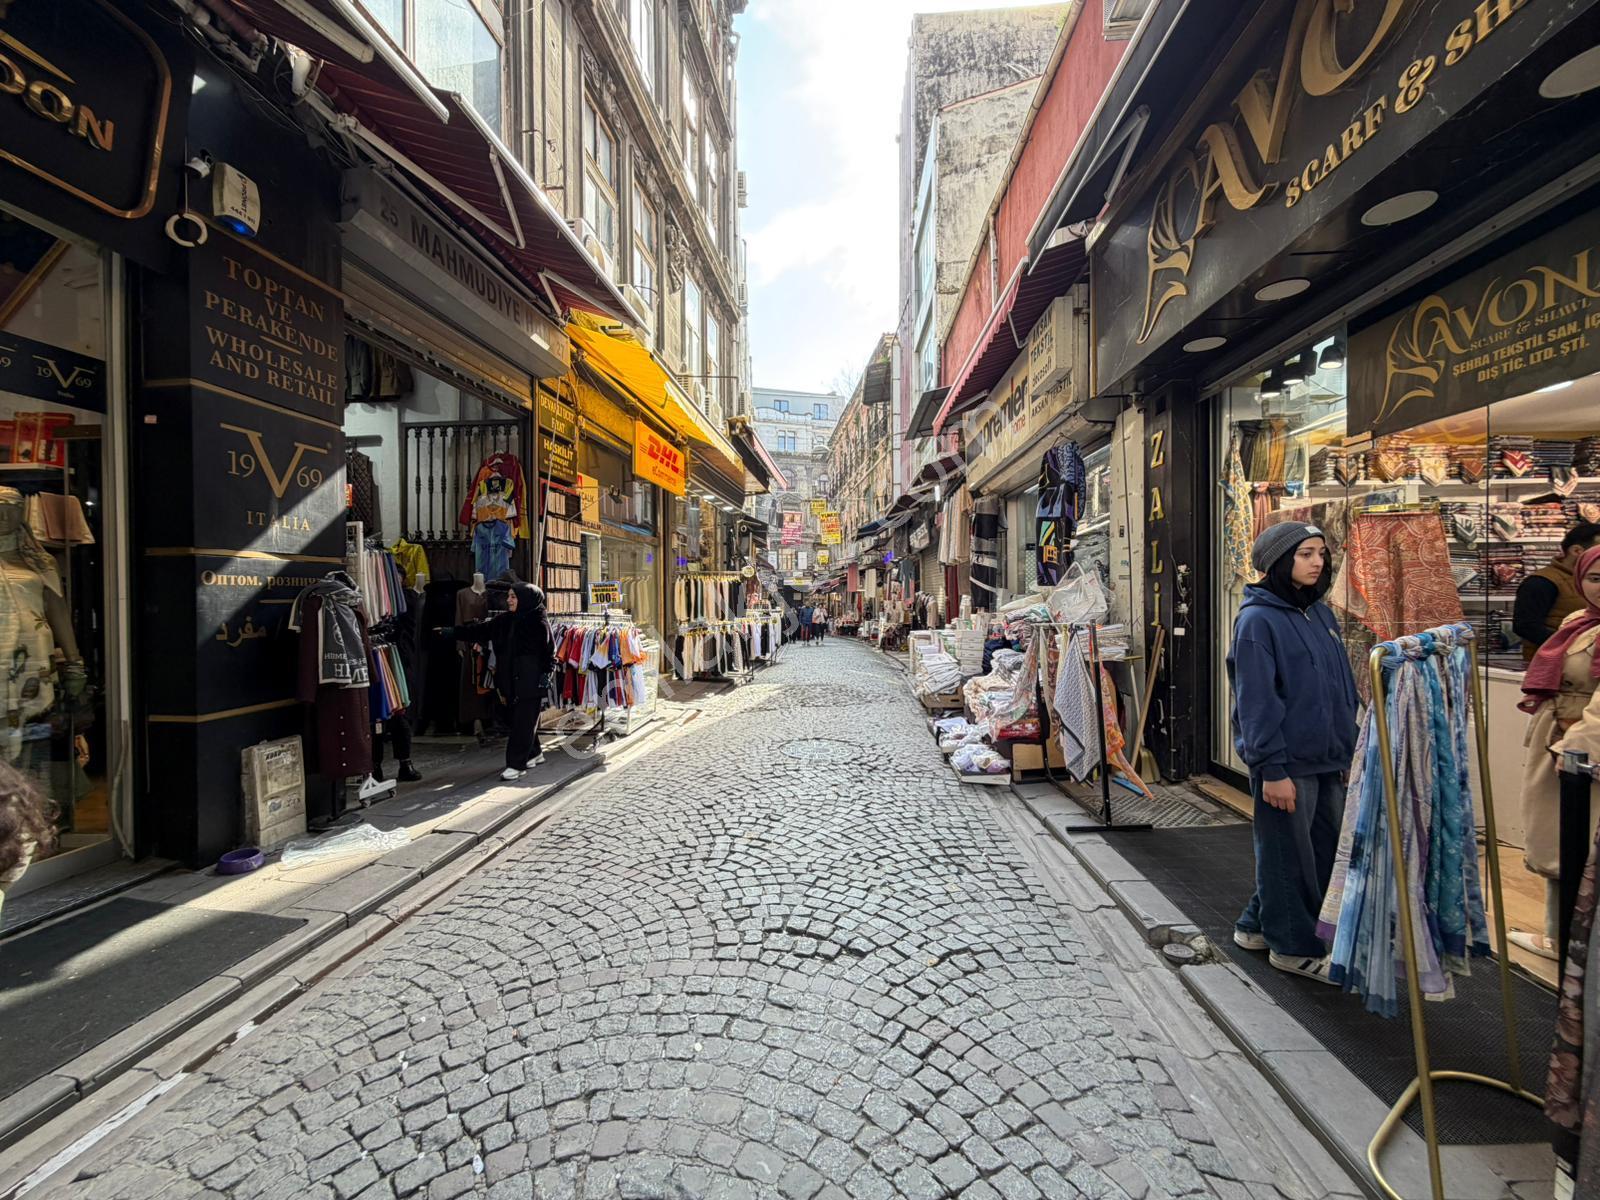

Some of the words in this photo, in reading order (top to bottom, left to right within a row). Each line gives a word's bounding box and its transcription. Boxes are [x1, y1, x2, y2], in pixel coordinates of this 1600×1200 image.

[1285, 96, 1388, 208] SCARF
[1394, 54, 1438, 114] &
[1443, 0, 1538, 67] SH
[380, 199, 399, 228] 25
[223, 256, 326, 322] TOPTAN
[1426, 249, 1600, 357] AVON
[204, 290, 338, 362] PERAKENDE
[265, 298, 293, 325] VE
[206, 326, 338, 390] WHOLESALE
[1492, 334, 1545, 362] TEKSTİL
[1547, 319, 1582, 343] SAN.
[209, 350, 260, 380] AND
[267, 368, 337, 407] RETAIL
[648, 434, 680, 475] DHL
[246, 510, 311, 532] ITALIA
[201, 570, 263, 588] Оптом.
[595, 592, 612, 603] 100
